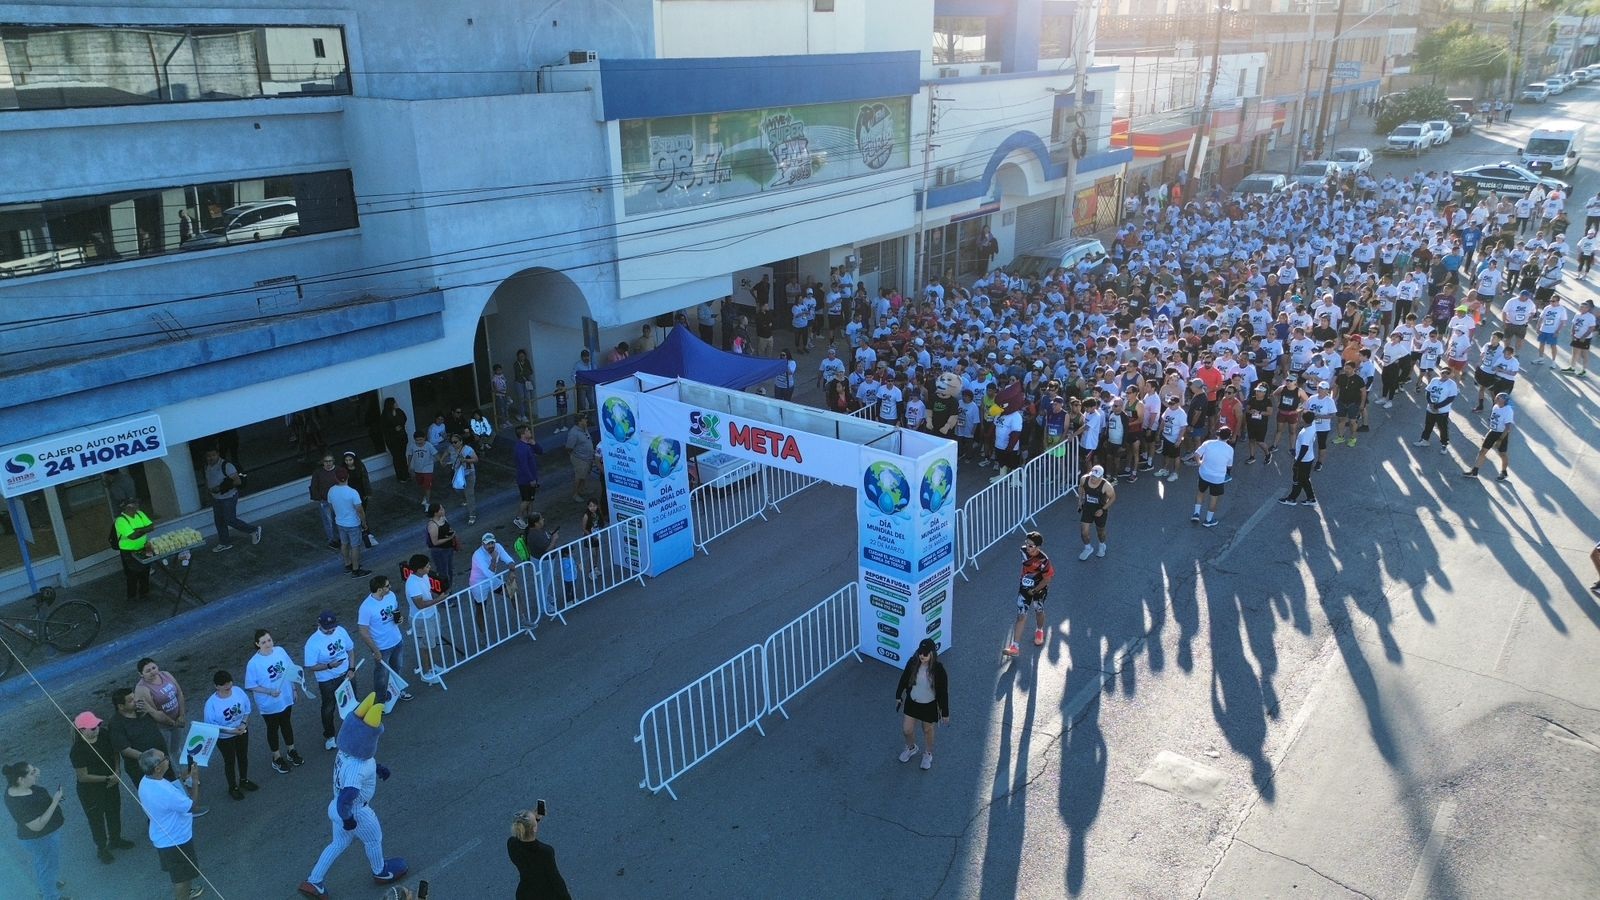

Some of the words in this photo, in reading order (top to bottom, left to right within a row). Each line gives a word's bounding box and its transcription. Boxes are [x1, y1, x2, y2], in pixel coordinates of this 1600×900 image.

[38, 444, 82, 461] CAJERO
[86, 436, 115, 449] AUTO
[118, 426, 156, 442] MÁTICO
[729, 421, 802, 464] META
[44, 456, 75, 477] 24
[80, 435, 160, 468] HORAS
[7, 472, 35, 483] simas
[660, 484, 672, 495] DÍA
[649, 492, 675, 509] MUNDIAL
[676, 488, 686, 496] DEL
[660, 500, 677, 512] AGUA
[668, 505, 686, 516] MARZO
[880, 520, 891, 529] DÍA
[930, 517, 939, 527] DÍA
[867, 524, 893, 536] MUNDIAL
[895, 532, 905, 540] DEL
[921, 525, 940, 540] MUNDIAL
[878, 535, 895, 544] AGUA
[885, 544, 904, 554] MARZO
[866, 571, 890, 583] REPORTA
[890, 580, 910, 590] FUGAS
